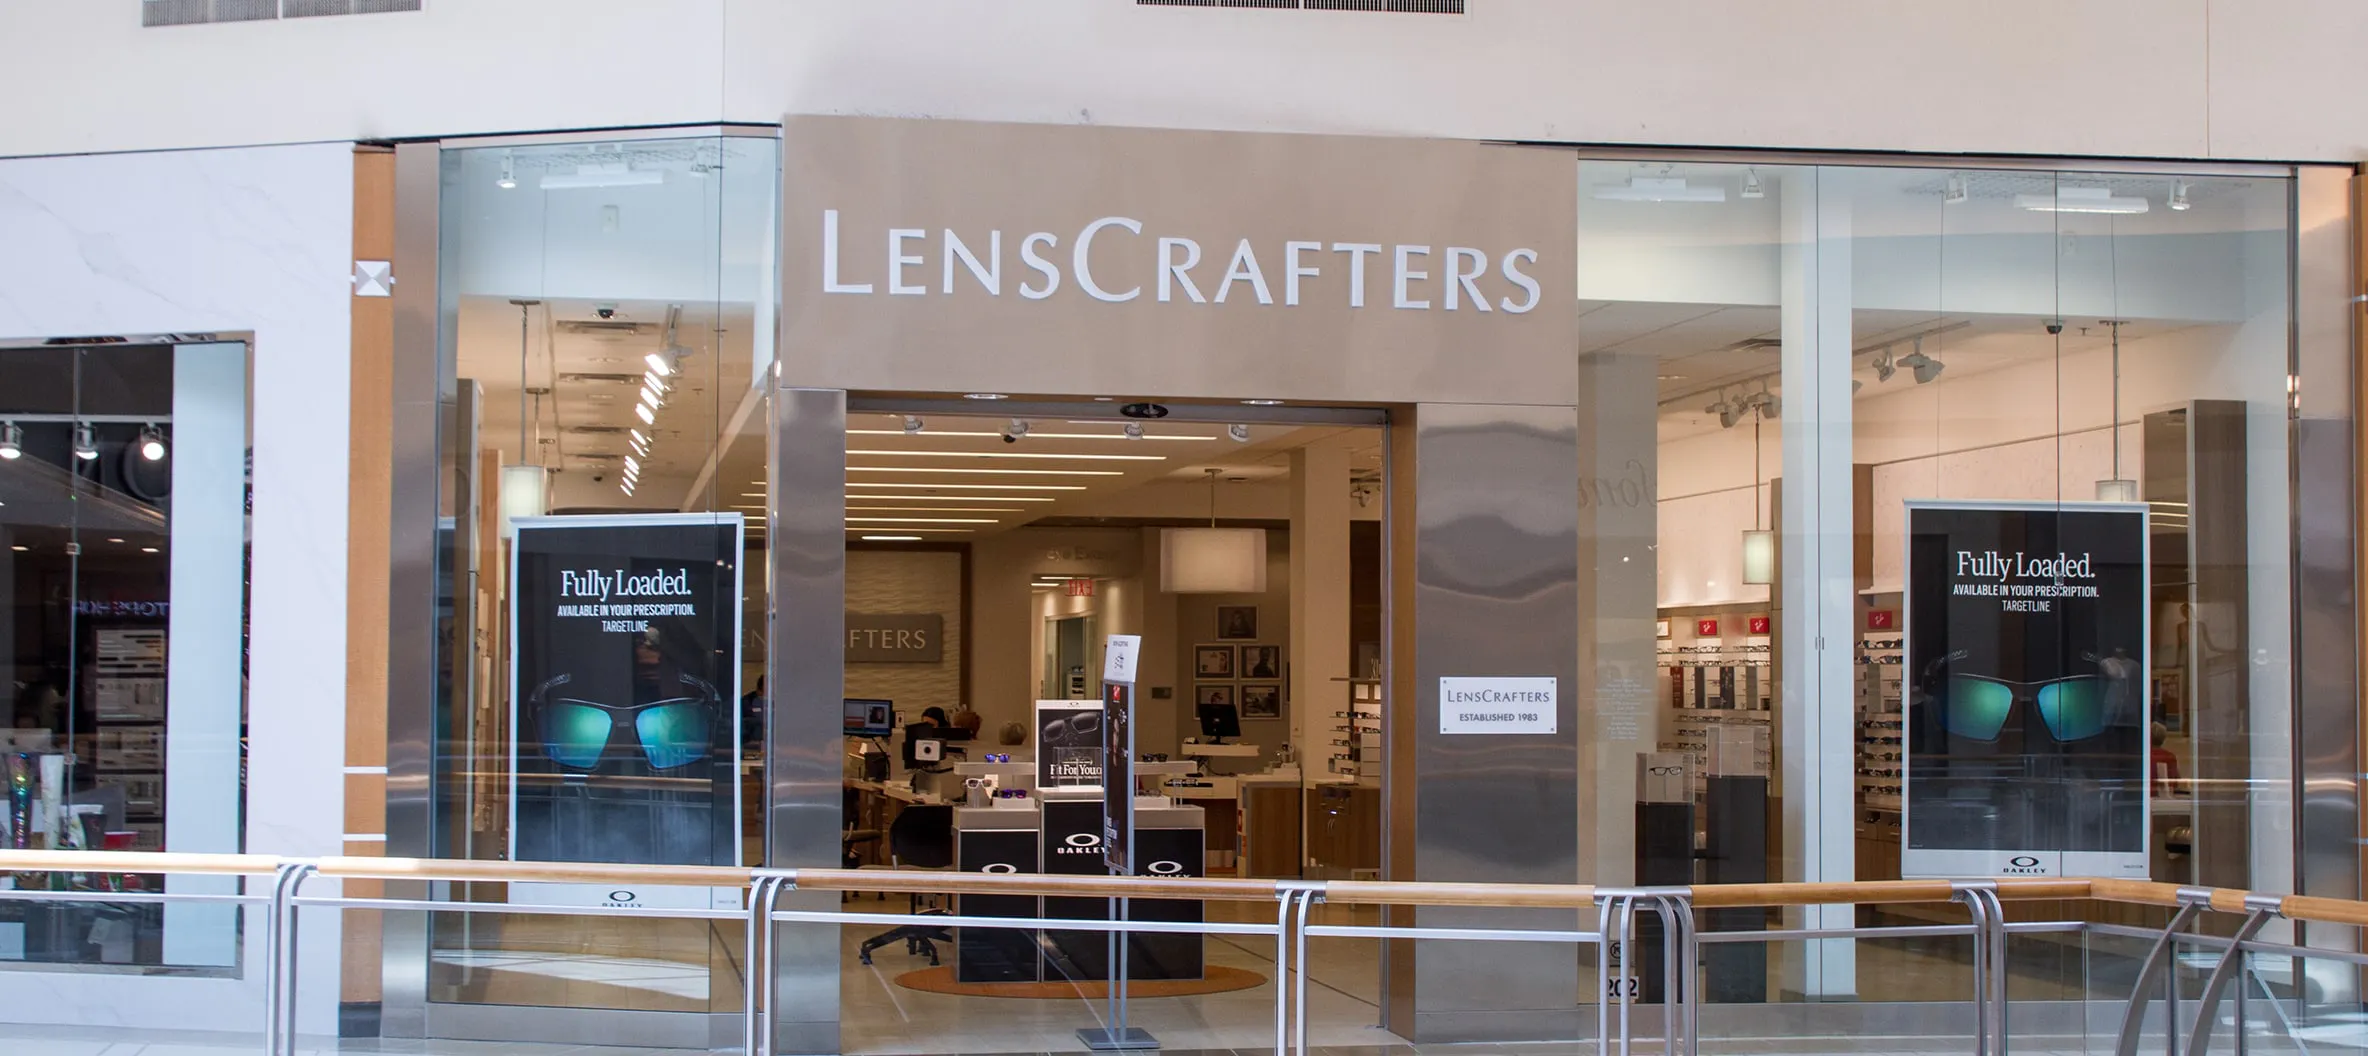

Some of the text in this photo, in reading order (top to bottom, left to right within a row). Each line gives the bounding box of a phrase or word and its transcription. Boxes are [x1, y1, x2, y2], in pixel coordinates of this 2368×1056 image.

[823, 208, 1542, 314] LENSCRAFTERS
[1957, 551, 2096, 583] Fully Loaded.
[561, 568, 692, 602] Fully Loaded.
[1953, 584, 2100, 597] AVAILABLE IN YOUR PRESCRIPTION.
[557, 604, 696, 616] AVAILABLE IN YOUR PRESCRIPTION.
[2002, 600, 2050, 612] TARGETLINE
[602, 620, 649, 632] TARGETLINE
[1447, 689, 1550, 703] LENSCRAFTERS
[1459, 713, 1538, 722] ESTABLISHED 1983
